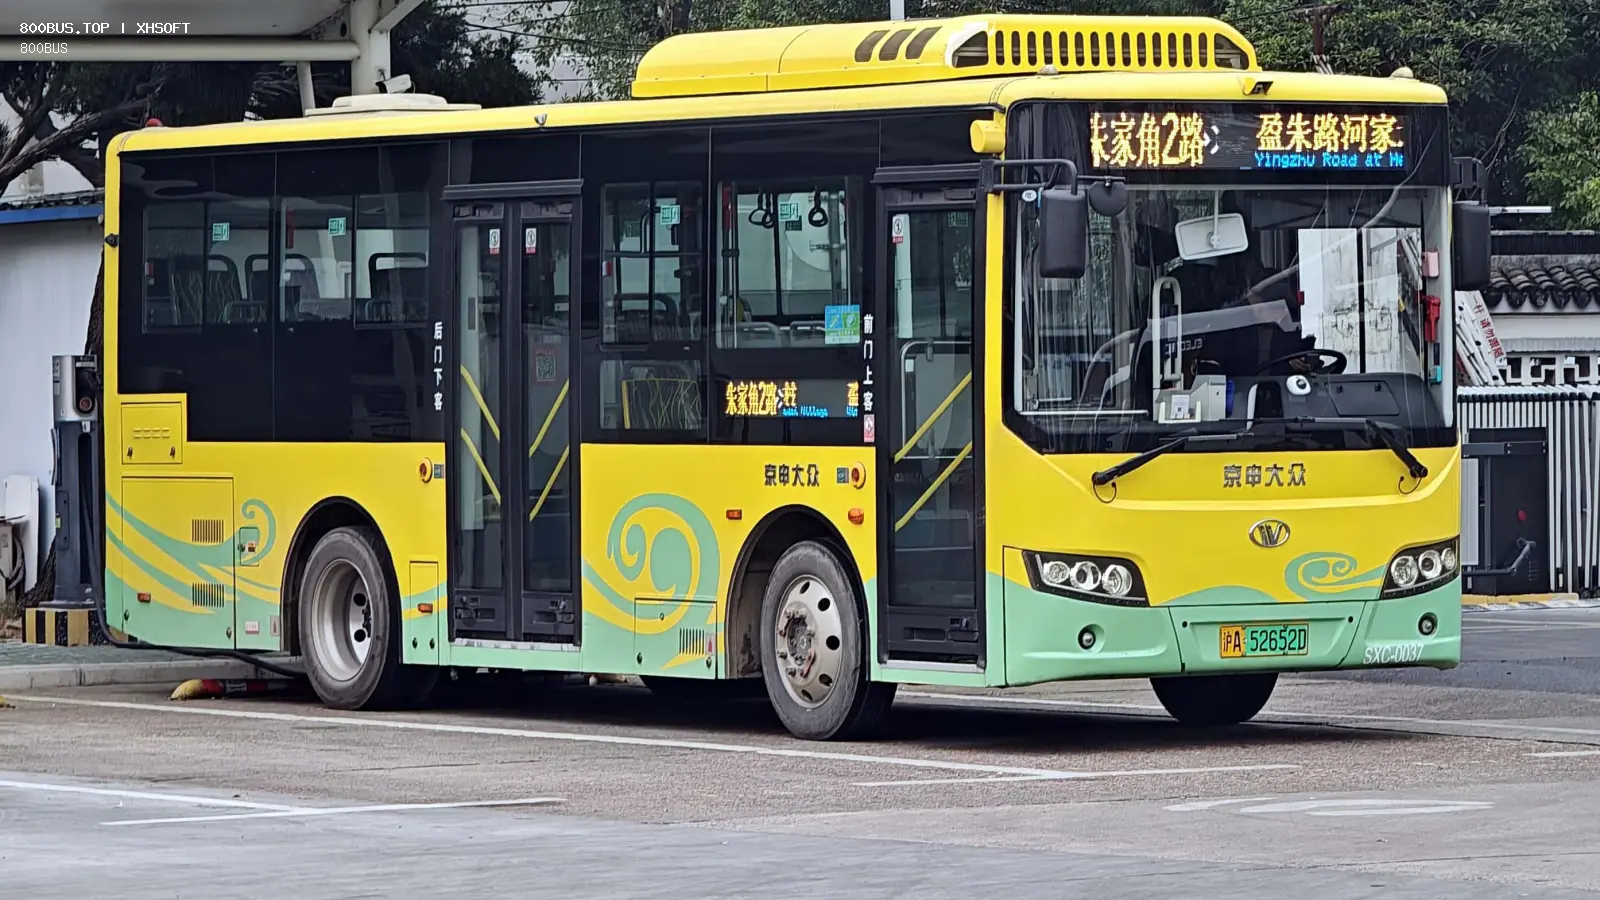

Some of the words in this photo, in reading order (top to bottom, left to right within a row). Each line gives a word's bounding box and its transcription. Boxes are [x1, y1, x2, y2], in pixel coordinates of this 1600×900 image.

[1256, 112, 1404, 154] 盈朱路河家
[1254, 151, 1315, 168] Yingzhu
[1322, 151, 1358, 168] Road
[1365, 151, 1383, 168] at
[433, 321, 443, 411] 后门下客
[863, 313, 874, 412] 前门上客
[764, 464, 820, 487] 京申大众
[1223, 463, 1307, 488] 京申大众
[1250, 628, 1307, 652] 52652D
[1362, 643, 1424, 665] SXC-0037
